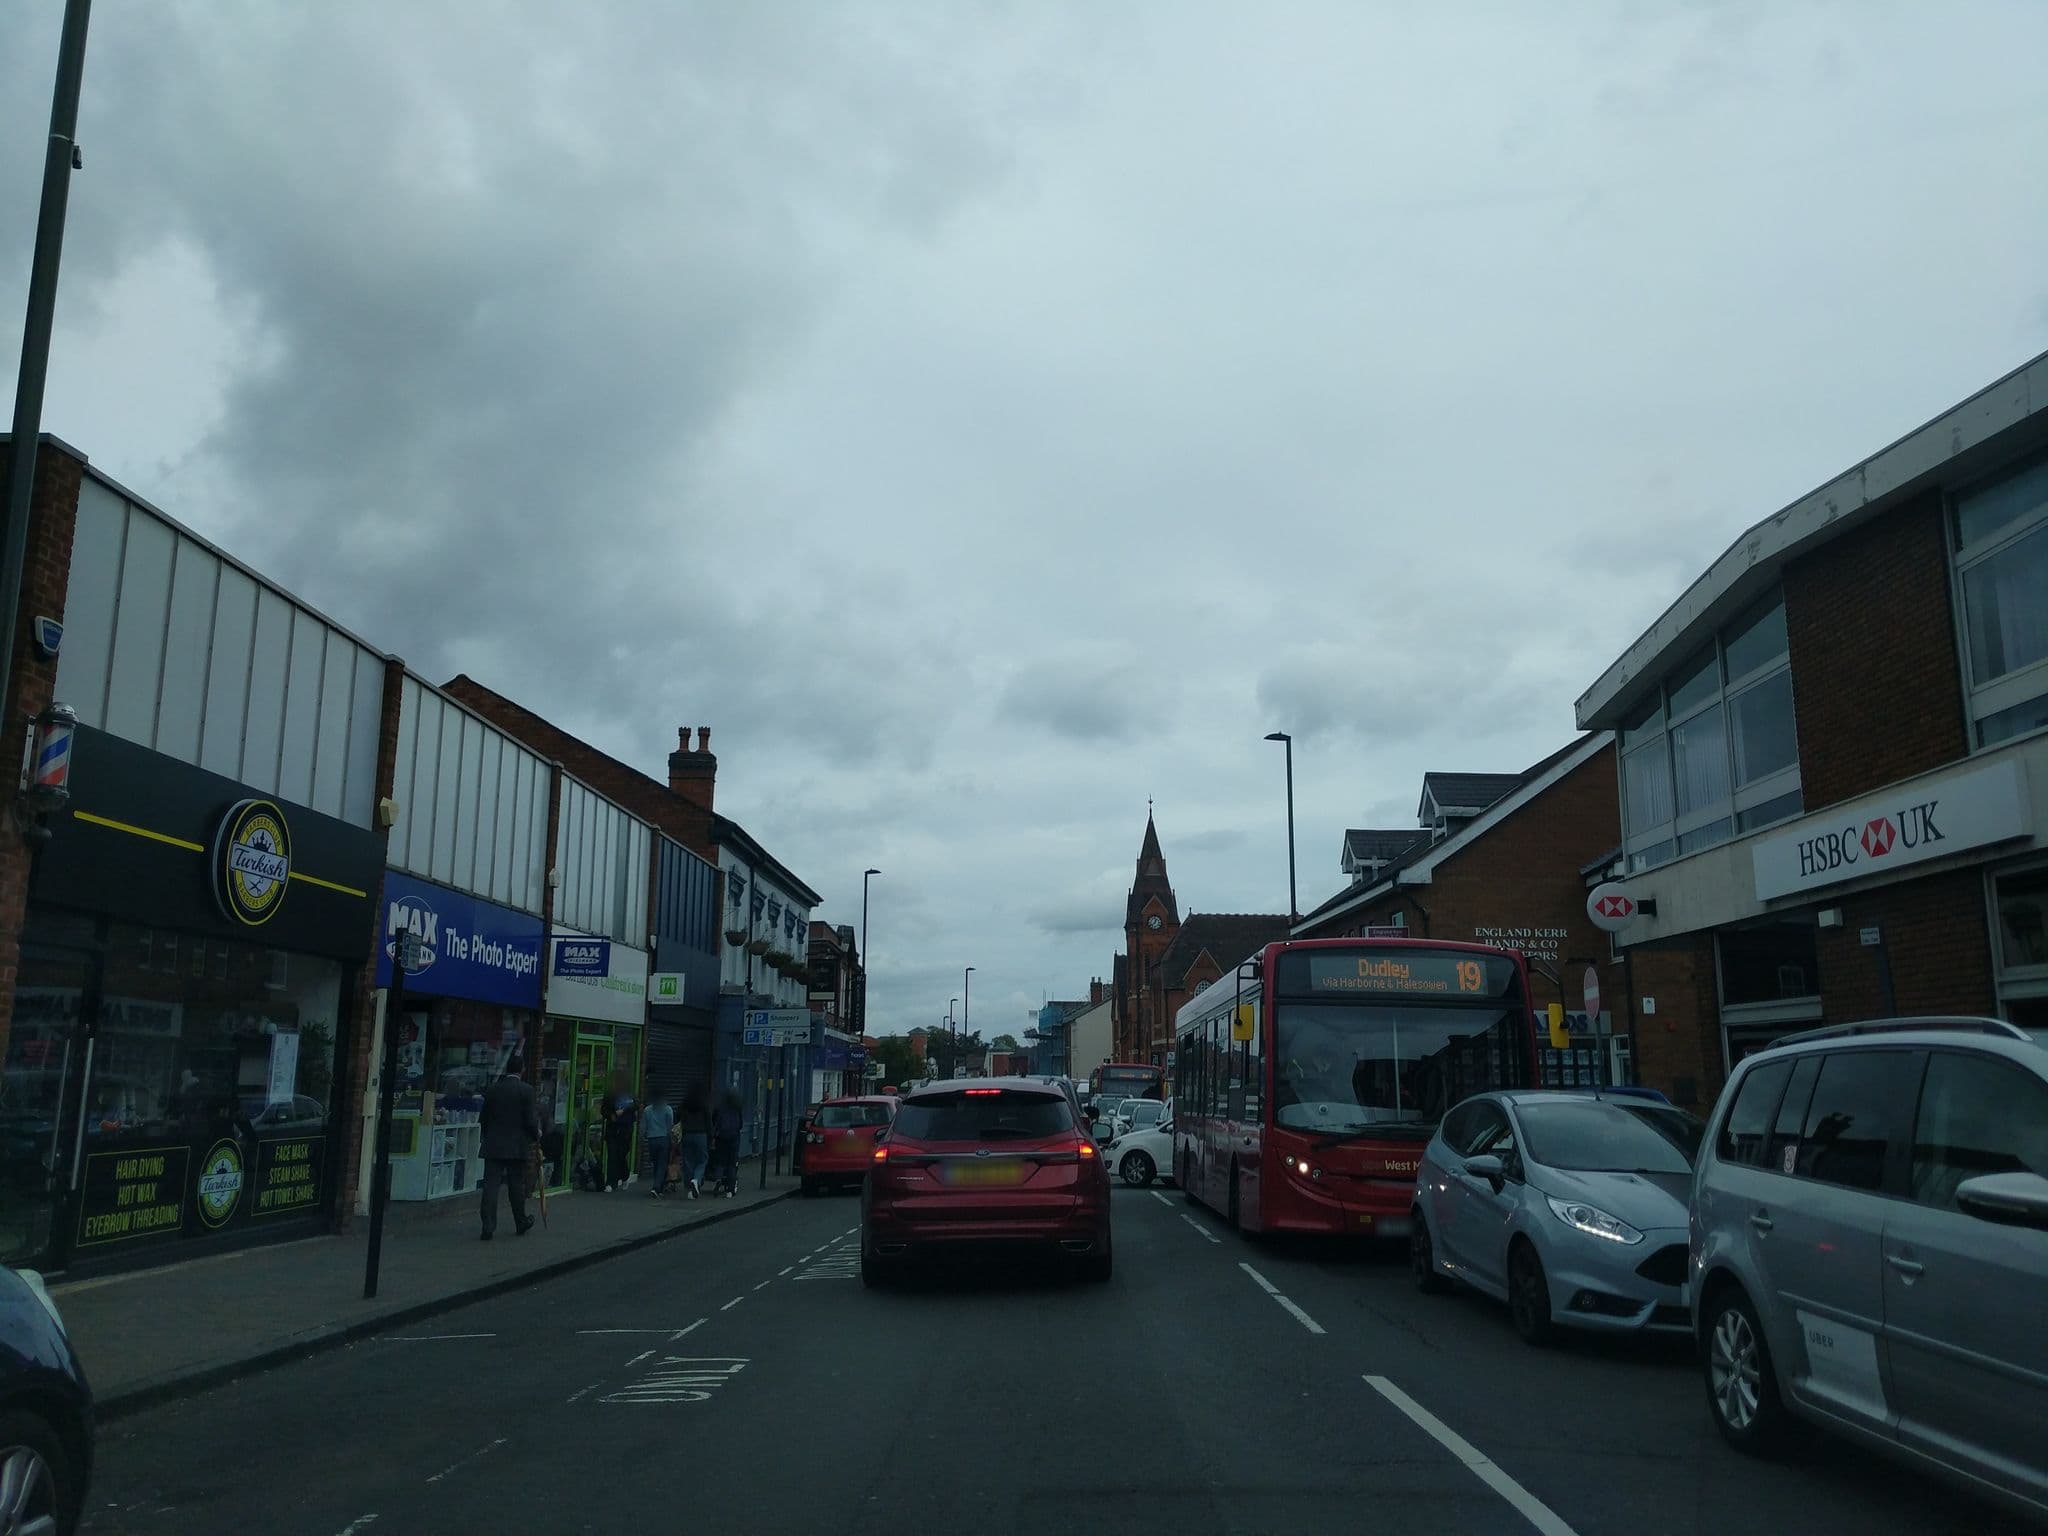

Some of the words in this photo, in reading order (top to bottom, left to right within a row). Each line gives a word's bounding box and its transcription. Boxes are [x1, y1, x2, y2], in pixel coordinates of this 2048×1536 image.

[1798, 827, 1858, 877] HSBC
[1896, 800, 1946, 848] UK
[234, 848, 285, 878] Turkish
[388, 902, 439, 945] MAX
[1474, 927, 1531, 937] ENGLAND
[1534, 928, 1569, 938] KERR
[446, 927, 468, 960] The
[472, 934, 503, 968] Photo
[505, 943, 538, 978] Expert
[563, 947, 601, 958] MAX
[1484, 938, 1526, 949] HANDS
[1528, 939, 1537, 949] &
[1540, 939, 1558, 949] CO
[1339, 977, 1386, 989] Harborne
[1387, 978, 1394, 989] &
[1396, 978, 1448, 990] Halesowen
[1358, 959, 1409, 979] Dudley
[1456, 960, 1482, 992] 19
[275, 1144, 291, 1162] FACE
[291, 1143, 310, 1161] MASK
[115, 1158, 138, 1180] HAIR
[138, 1156, 165, 1178] DYING
[268, 1165, 291, 1184] STEAM
[290, 1163, 312, 1182] SHAVE
[1384, 1159, 1411, 1171] West
[117, 1184, 137, 1206] HOT
[136, 1182, 158, 1203] WAX
[203, 1175, 239, 1192] Turkish
[259, 1189, 274, 1208] HOT
[273, 1186, 295, 1207] TOWEL
[294, 1183, 315, 1202] SHAVE
[85, 1211, 131, 1238] EYEBROW
[131, 1203, 179, 1230] THREADING
[1808, 1329, 1834, 1347] UBER
[599, 1356, 751, 1403] ONLY
